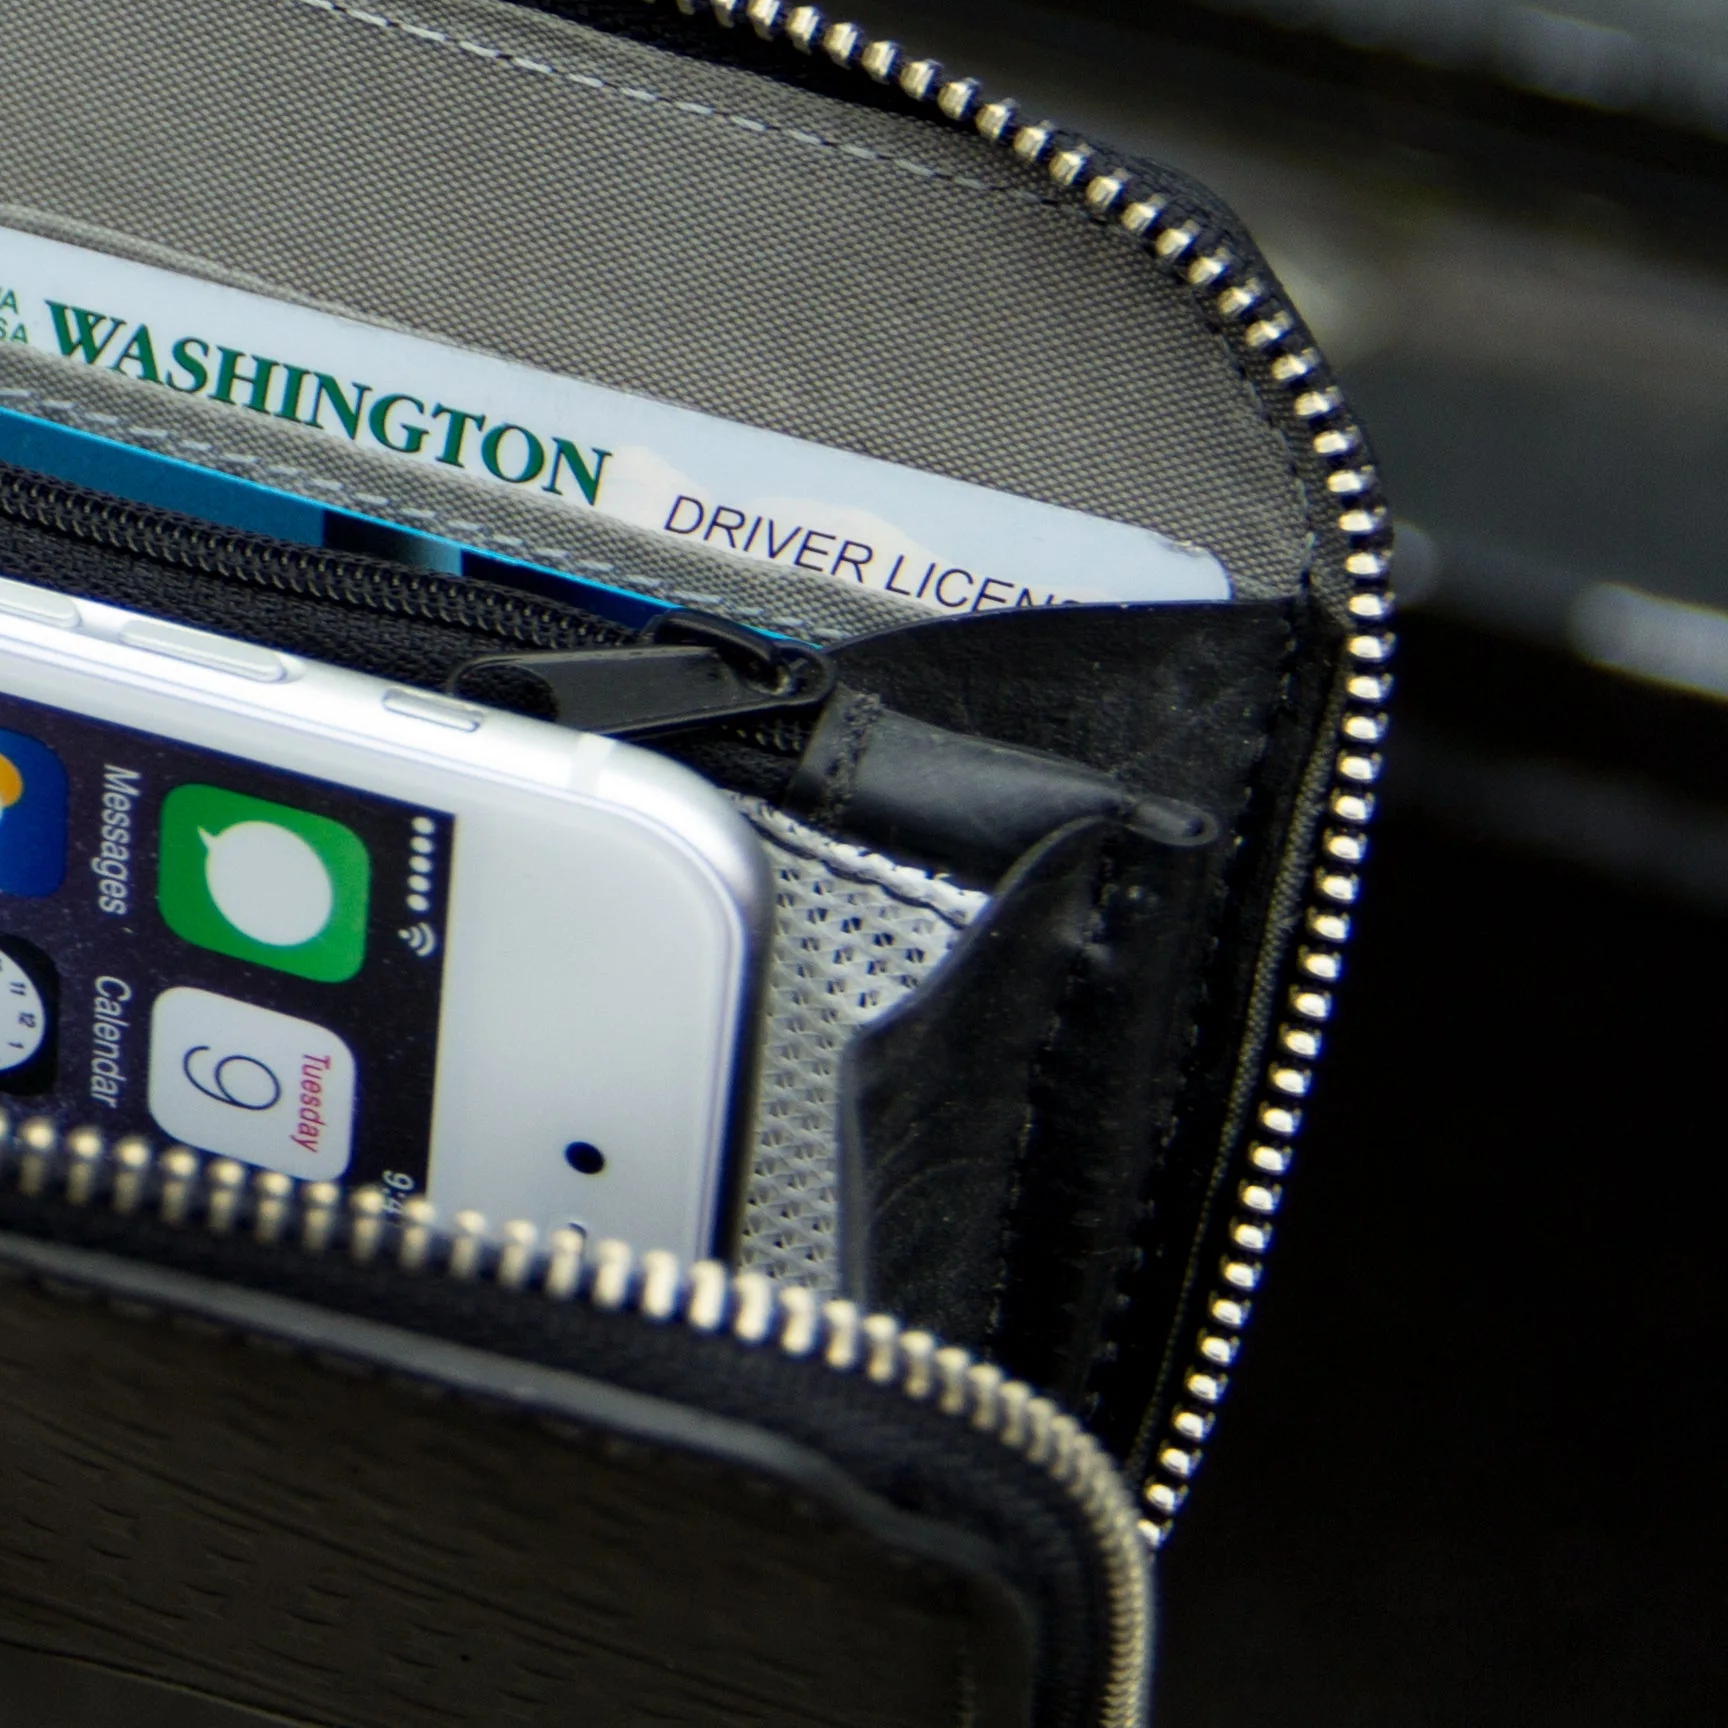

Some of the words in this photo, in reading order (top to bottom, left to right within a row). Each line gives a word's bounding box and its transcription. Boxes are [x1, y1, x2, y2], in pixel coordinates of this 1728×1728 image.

[44, 298, 613, 507] WASHINGTON
[663, 495, 874, 584] DRIVER
[89, 762, 142, 916] Messages
[10, 982, 26, 996] 11
[18, 1012, 36, 1028] 12
[90, 974, 134, 1109] Calendar
[183, 1045, 281, 1111] 9
[290, 1054, 331, 1153] Tuesday
